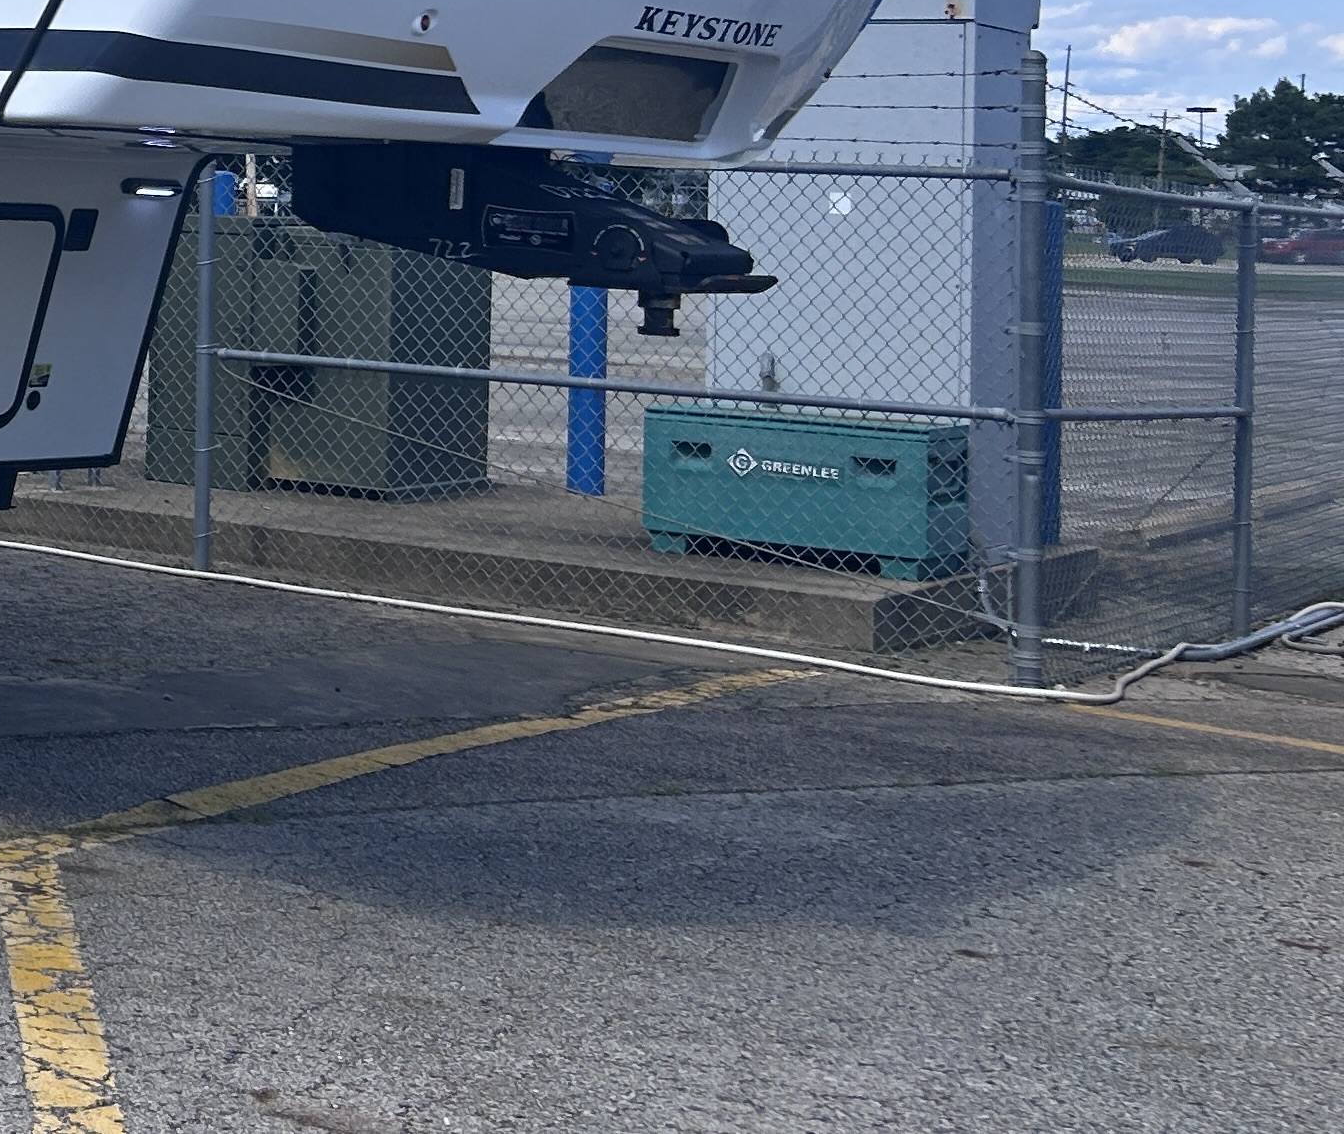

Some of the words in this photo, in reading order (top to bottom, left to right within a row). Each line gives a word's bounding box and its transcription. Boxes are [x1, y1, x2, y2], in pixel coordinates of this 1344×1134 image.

[633, 5, 783, 48] KEYSTONE
[428, 237, 475, 259] 722
[761, 460, 840, 480] GREENLEE
